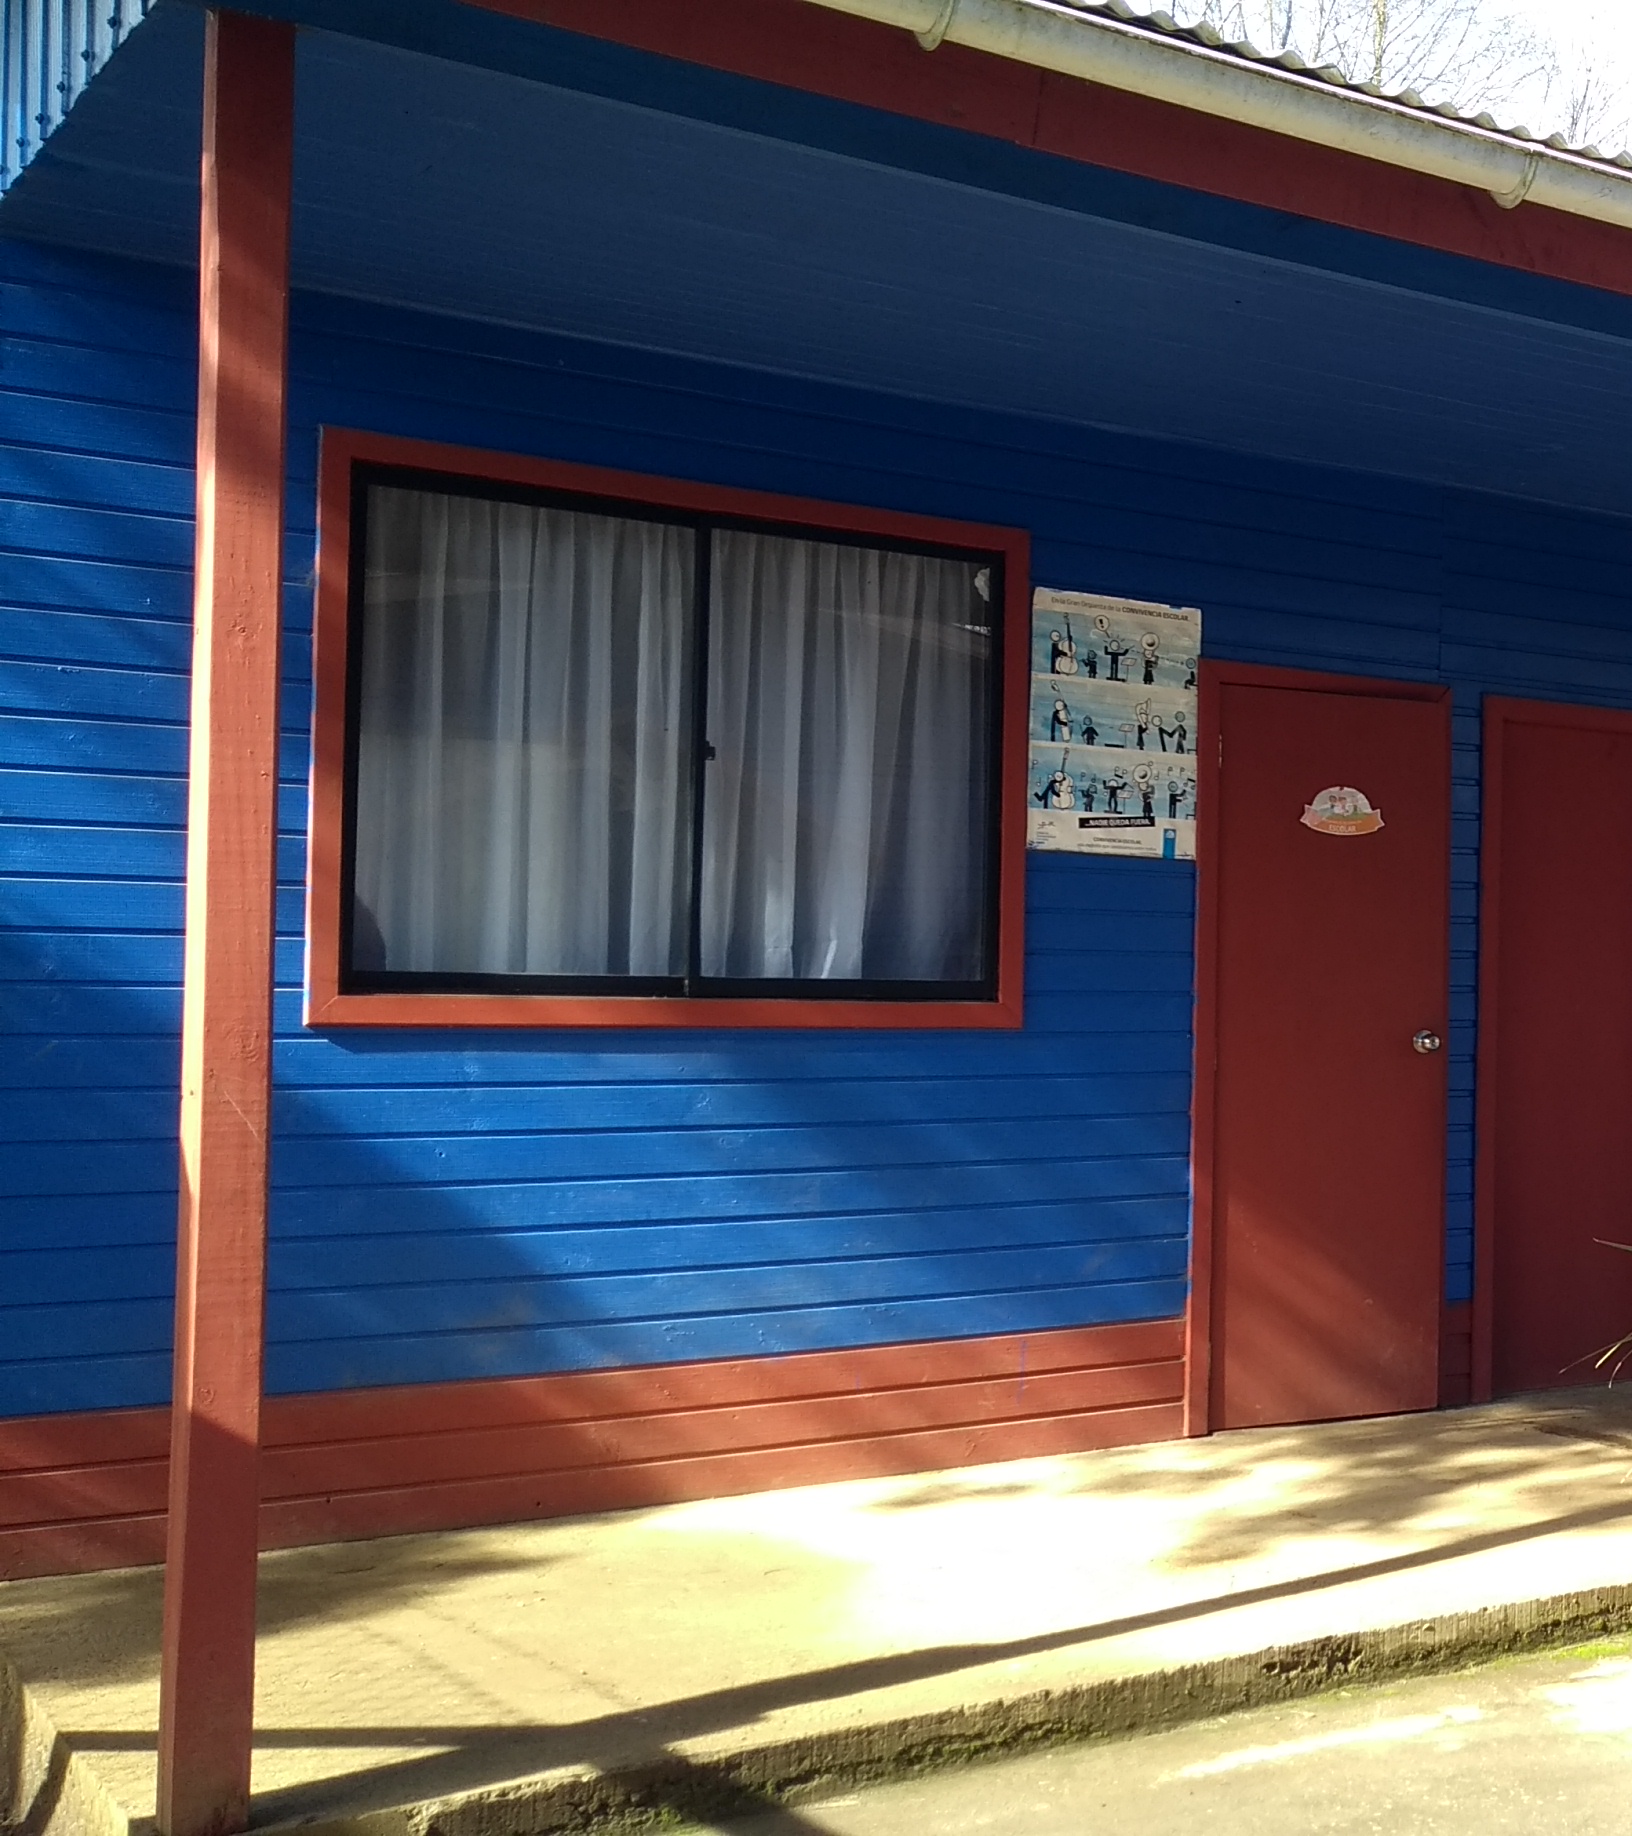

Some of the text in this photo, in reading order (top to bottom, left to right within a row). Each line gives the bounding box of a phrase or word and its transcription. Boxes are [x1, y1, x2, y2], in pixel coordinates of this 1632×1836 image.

[1067, 598, 1080, 606] Gran
[1122, 606, 1162, 618] CONVIVENCIA
[1109, 818, 1130, 826] QUEDA
[1328, 824, 1357, 833] ESCOLAR
